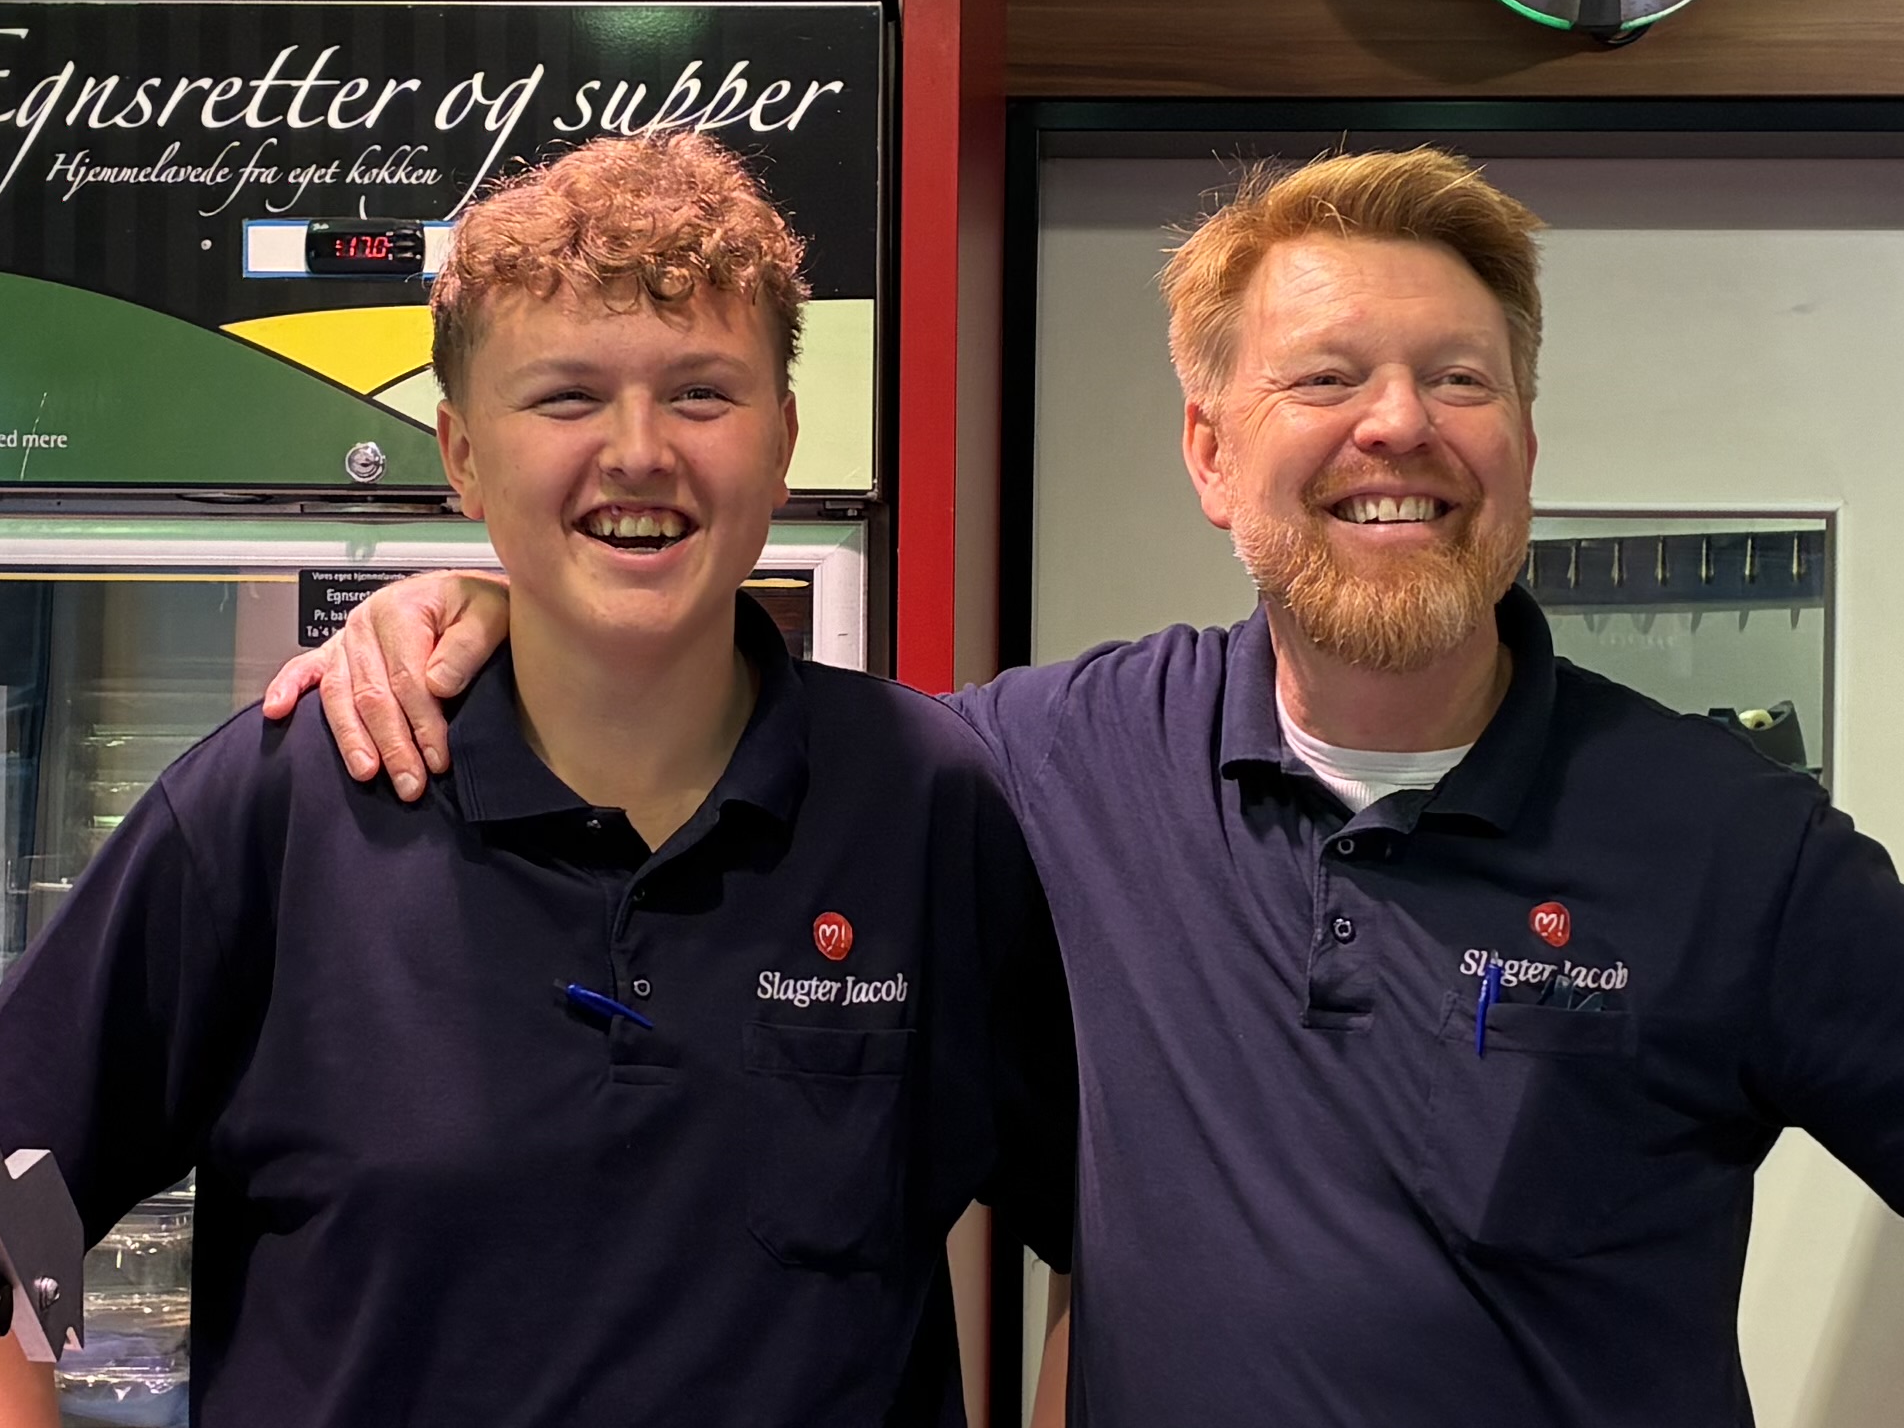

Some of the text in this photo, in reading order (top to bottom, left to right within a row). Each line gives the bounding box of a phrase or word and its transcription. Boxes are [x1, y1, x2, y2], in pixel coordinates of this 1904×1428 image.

[555, 60, 844, 141] supper
[45, 141, 240, 202] Hjemmelavede
[198, 137, 283, 217] fra
[265, 159, 339, 213] eget
[22, 433, 68, 448] mere
[326, 588, 371, 604] Egnsre
[314, 609, 328, 621] Pr.
[756, 970, 909, 1008] Slagter Jacob
